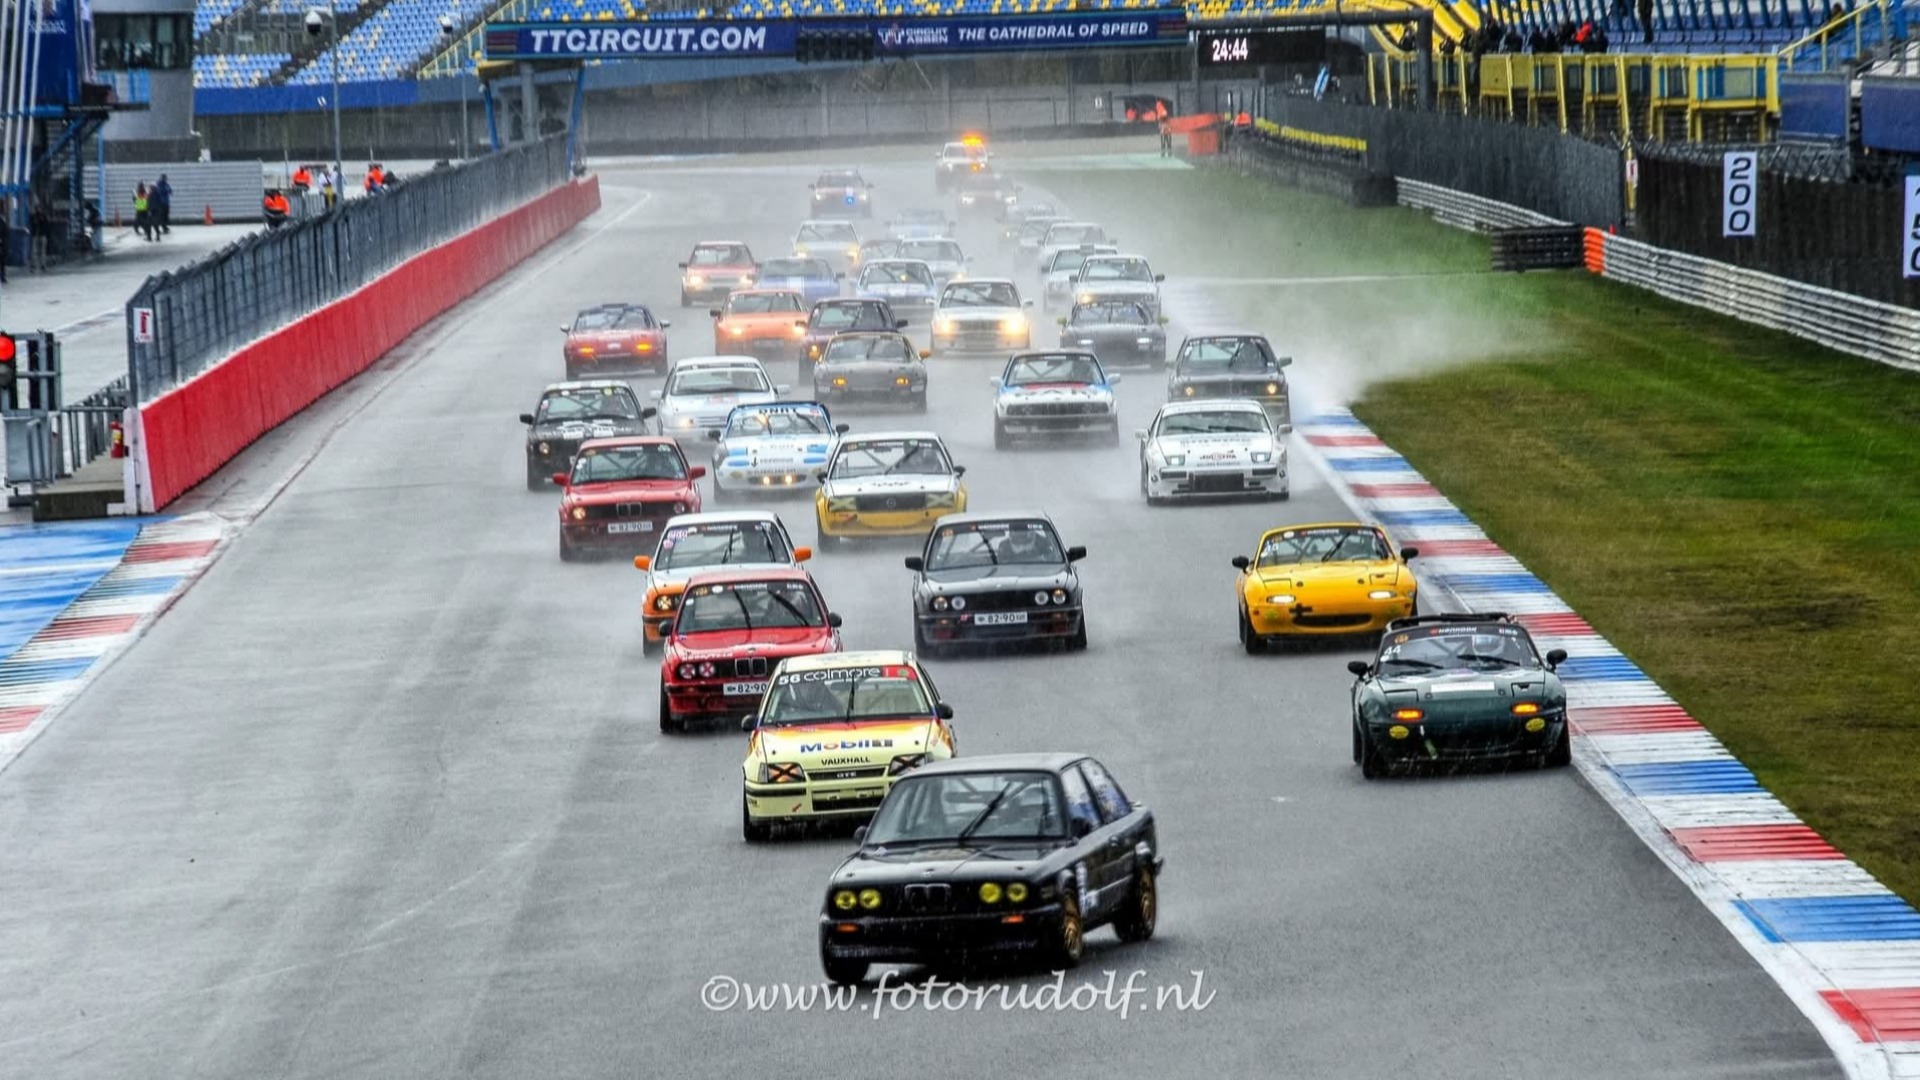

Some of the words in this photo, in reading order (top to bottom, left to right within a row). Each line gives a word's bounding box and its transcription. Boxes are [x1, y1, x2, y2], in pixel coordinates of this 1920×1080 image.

[531, 26, 766, 53] TTCIRCUIT.COM
[906, 27, 948, 35] CIRCUIT
[958, 27, 986, 41] THE
[989, 23, 1075, 40] CATHEDRAL
[1078, 23, 1099, 37] OF
[1101, 21, 1149, 36] SPEED
[1212, 37, 1249, 62] 24:44
[1728, 157, 1752, 233] 200
[778, 673, 801, 685] 56
[803, 667, 881, 681] colmore
[821, 756, 871, 766] VAUXHALL
